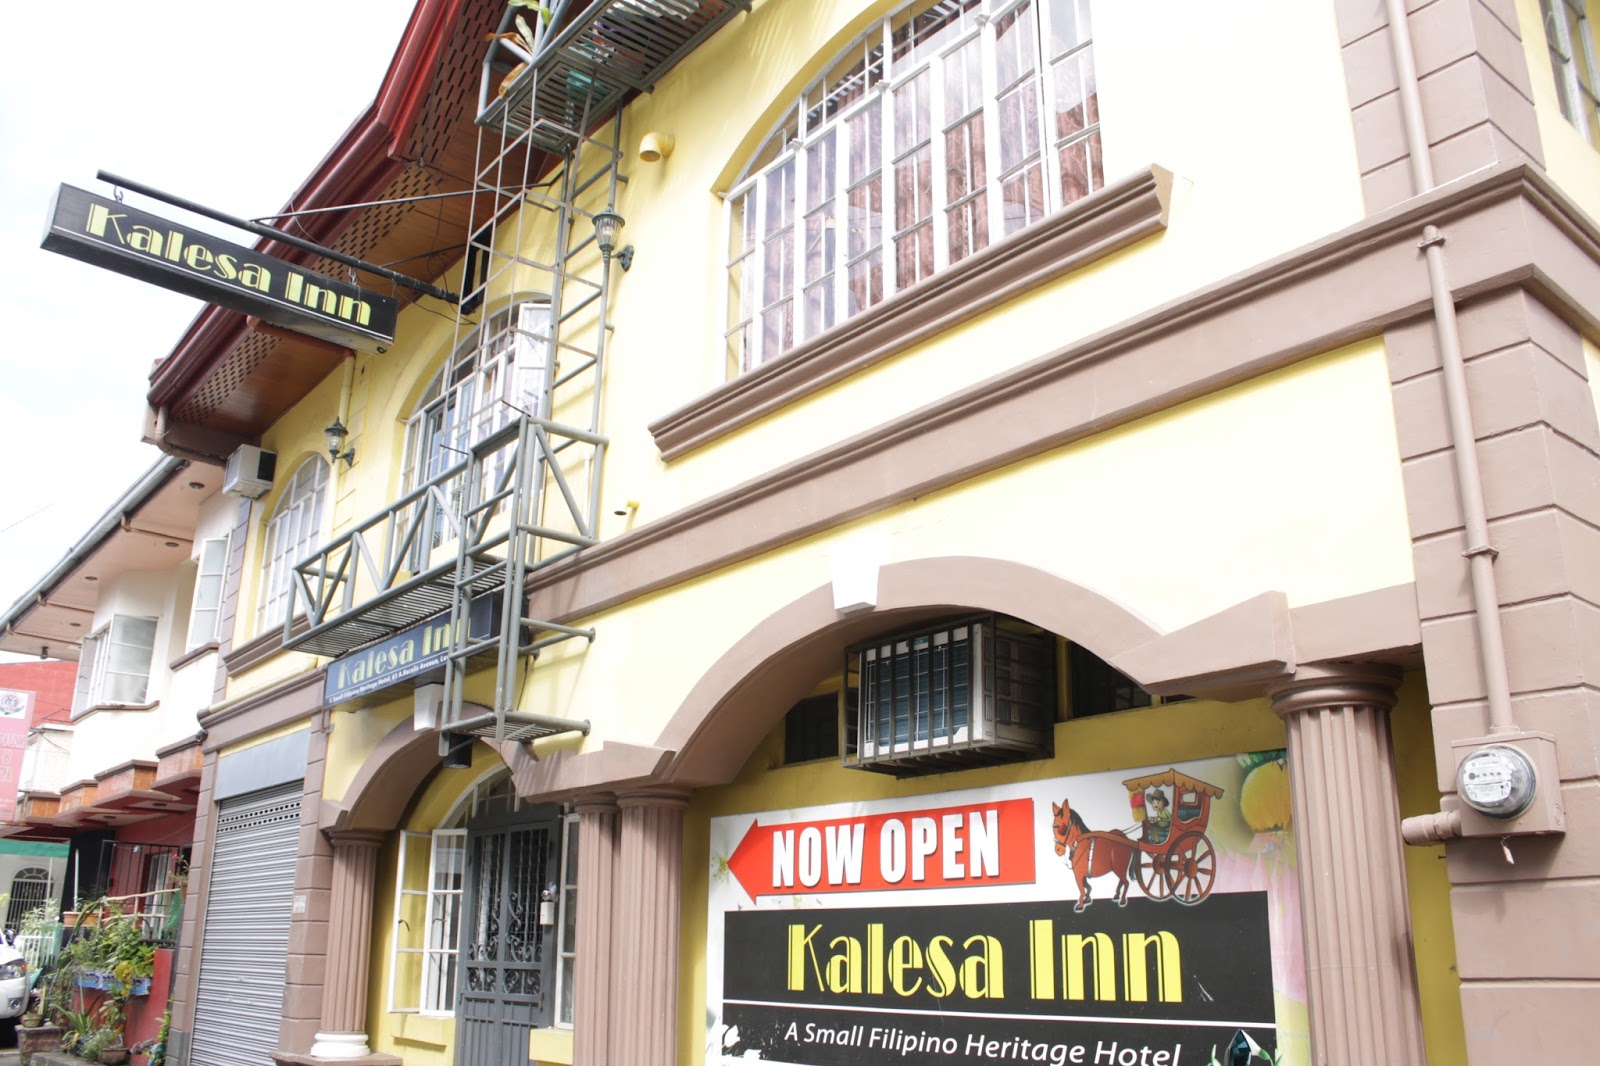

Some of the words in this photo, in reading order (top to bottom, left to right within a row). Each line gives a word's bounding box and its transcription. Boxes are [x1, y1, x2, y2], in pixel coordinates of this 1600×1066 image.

[86, 203, 271, 293] Kalesa
[285, 271, 371, 326] Inn
[338, 639, 414, 689] Kalesa
[772, 823, 865, 888] NOW
[879, 810, 999, 882] OPEN
[787, 922, 1004, 999] Kalesa
[1029, 919, 1183, 1003] Inn
[784, 1021, 799, 1042] A
[804, 1022, 863, 1048] Small
[869, 1027, 958, 1056] Filipino
[965, 1033, 1086, 1064] Heritage
[1094, 1040, 1182, 1066] Hotel
